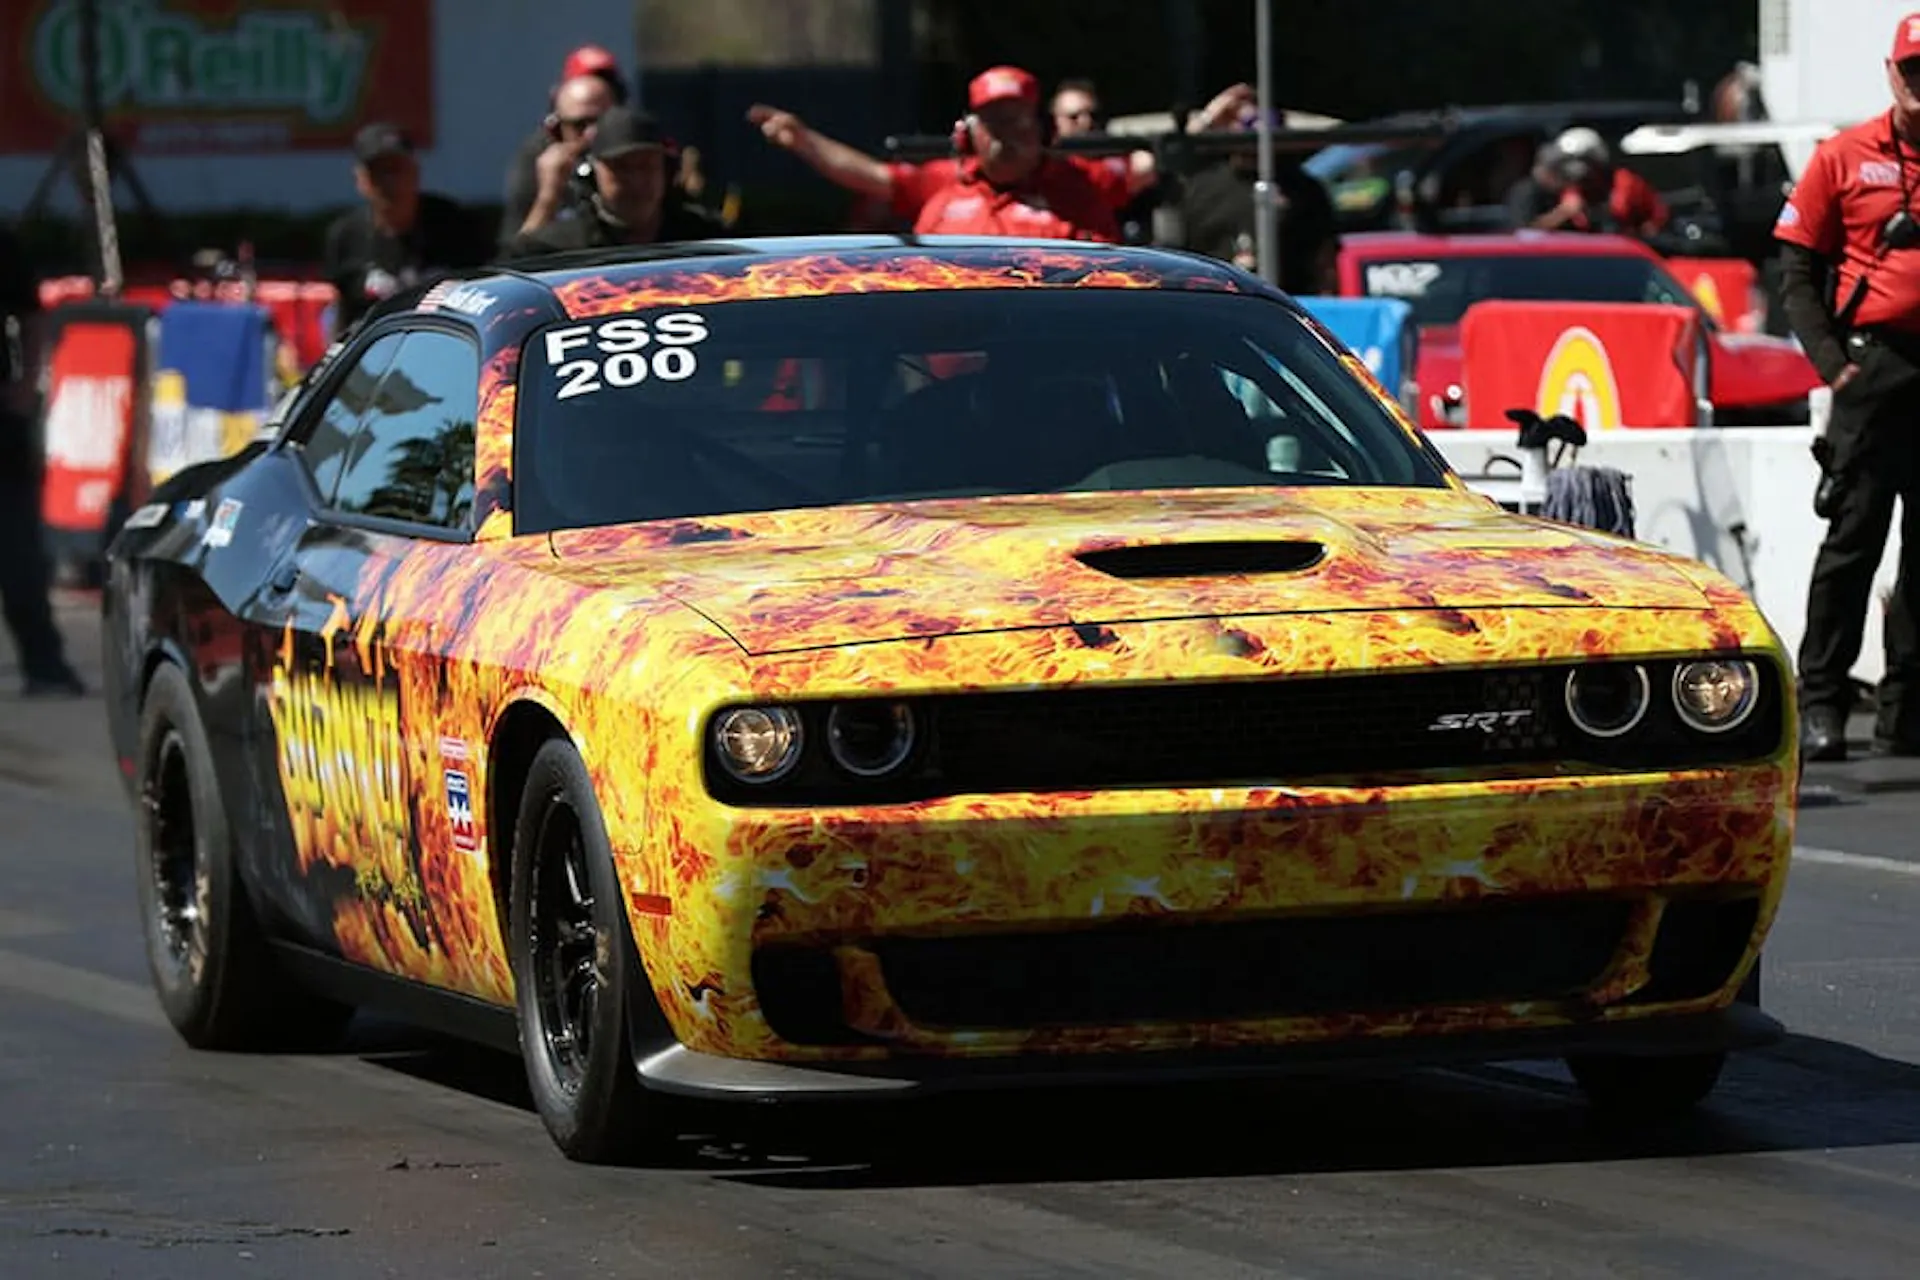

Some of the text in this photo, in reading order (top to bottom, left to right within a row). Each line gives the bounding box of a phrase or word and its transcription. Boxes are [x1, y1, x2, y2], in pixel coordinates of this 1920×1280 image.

[544, 312, 709, 366] FSS
[555, 346, 697, 400] 200
[1428, 710, 1533, 733] SRT
